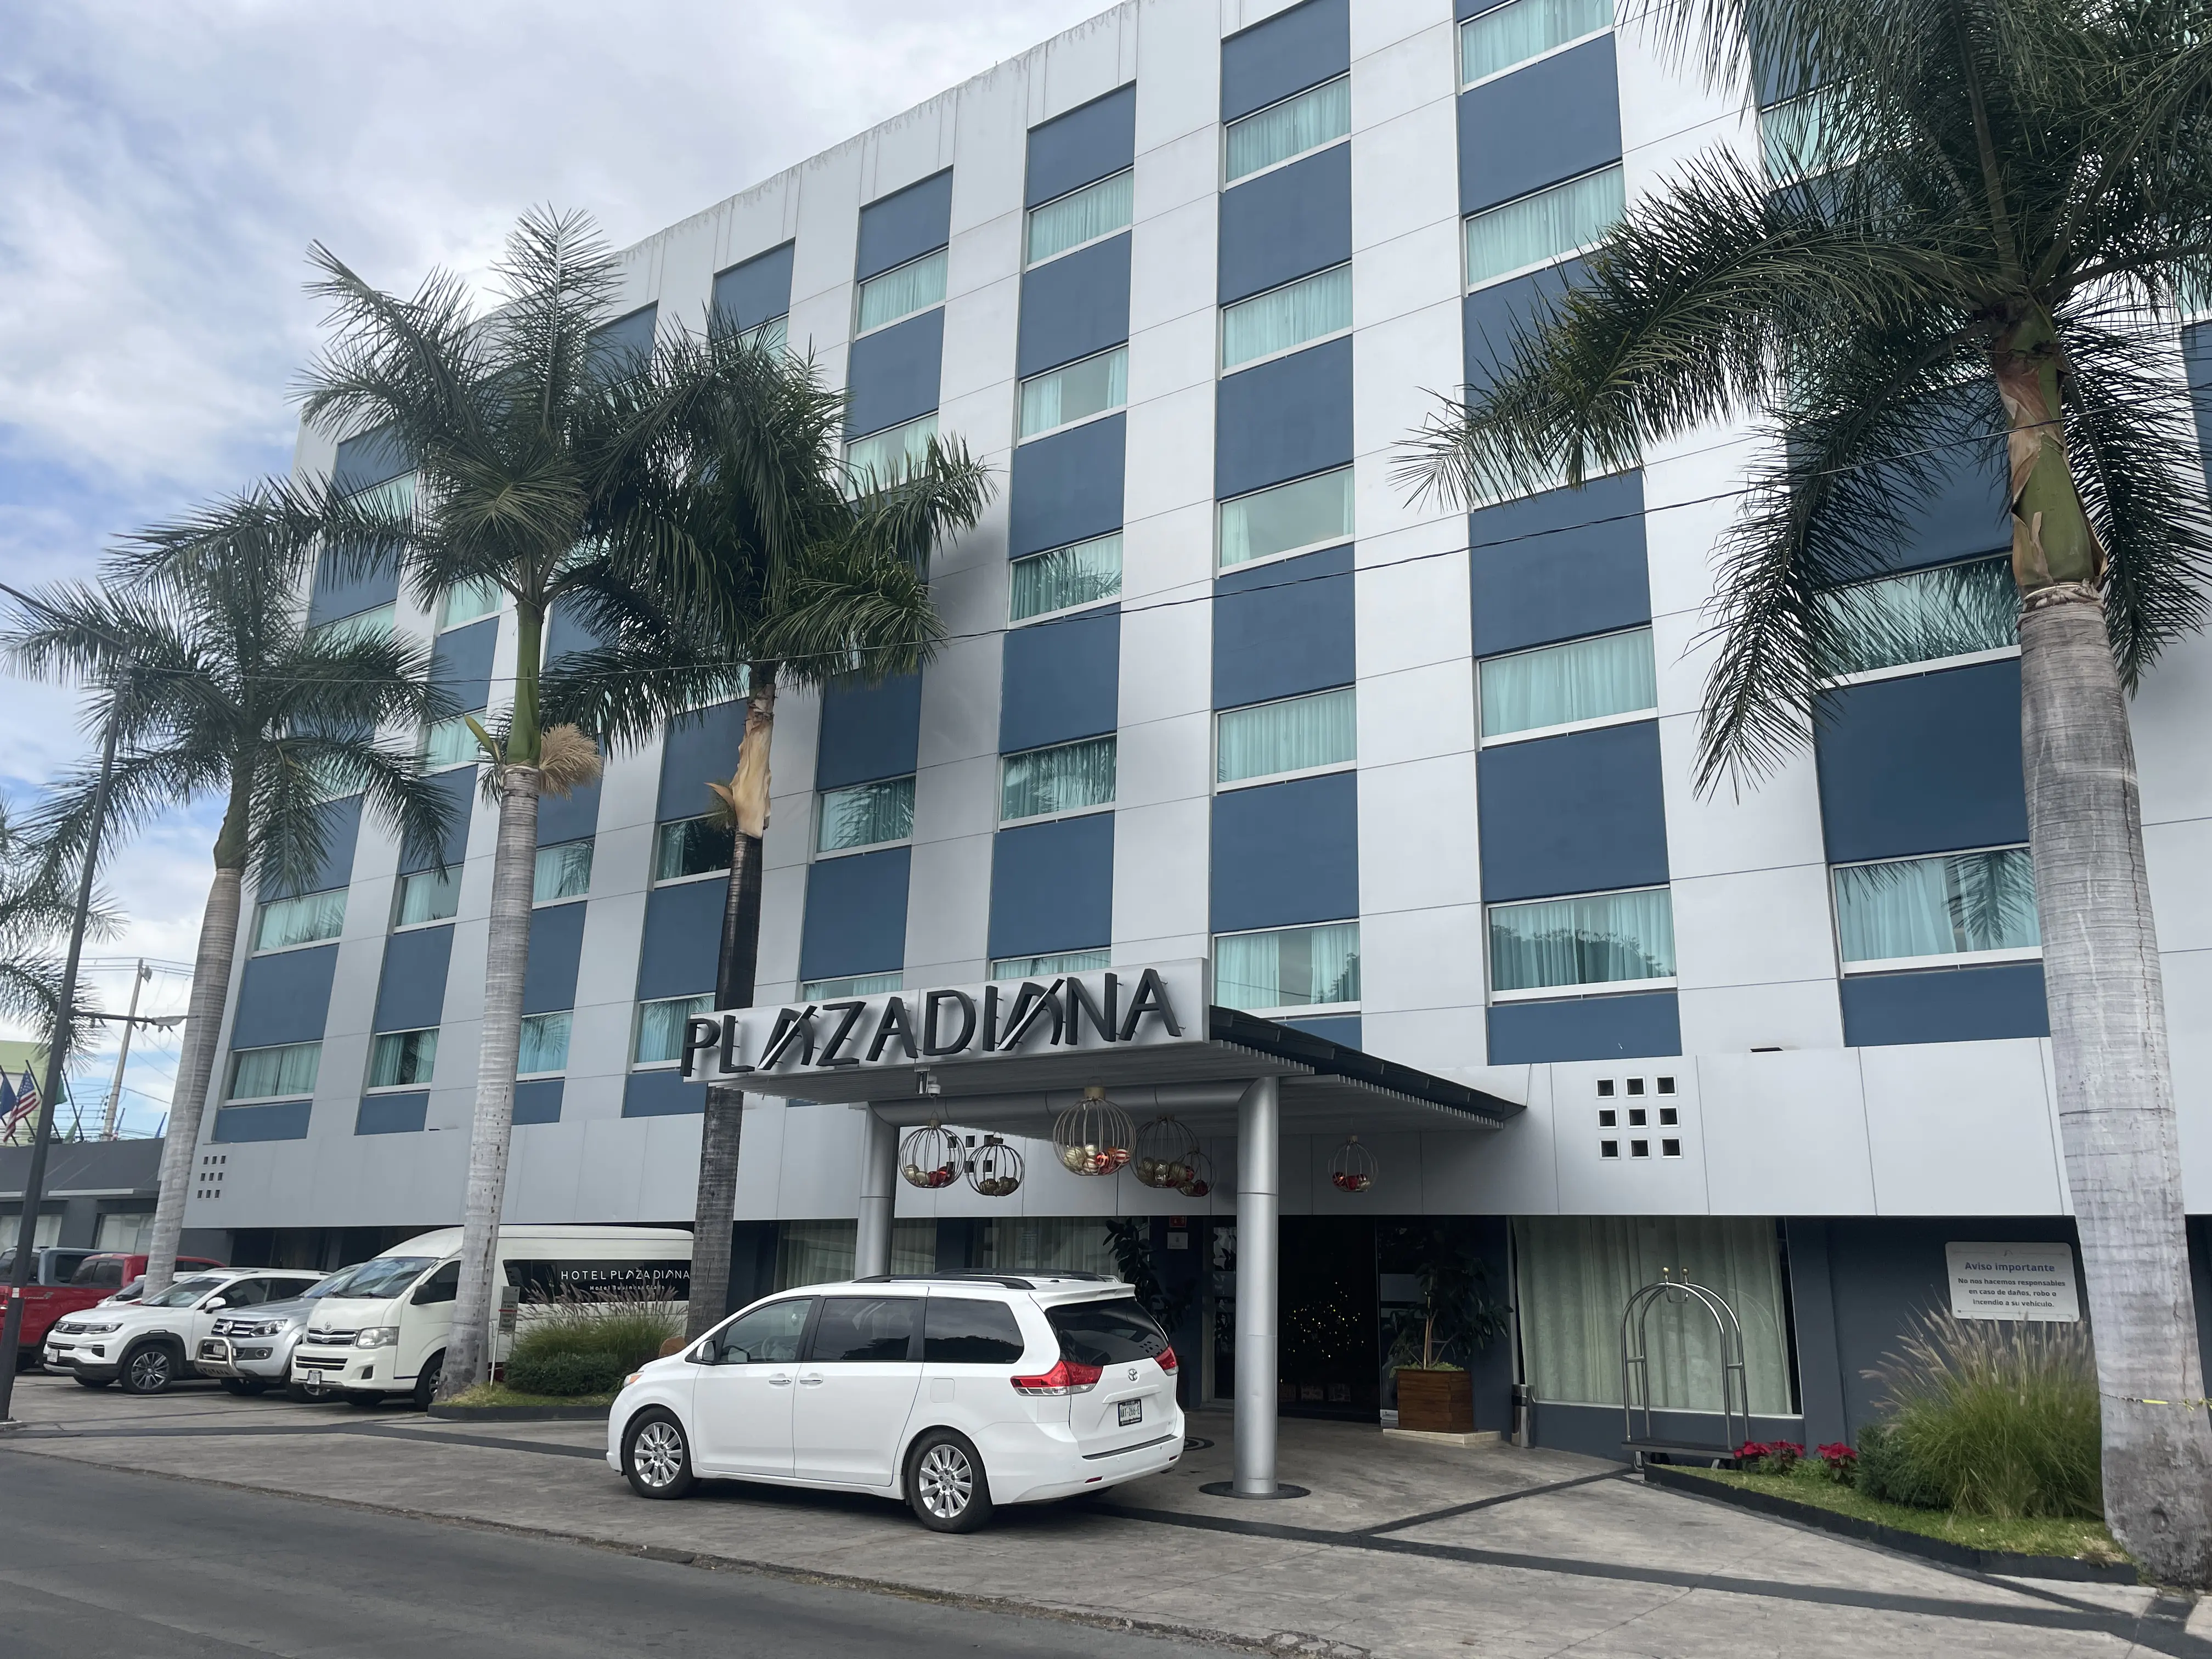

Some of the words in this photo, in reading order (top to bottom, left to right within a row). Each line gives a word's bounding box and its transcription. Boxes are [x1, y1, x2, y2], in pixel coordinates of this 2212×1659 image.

[1965, 1262, 1993, 1271] Aviso
[1995, 1262, 2055, 1273] importante
[561, 1270, 607, 1280] HOTEL
[611, 1269, 651, 1280] PLAZA
[653, 1269, 690, 1279] DIANA
